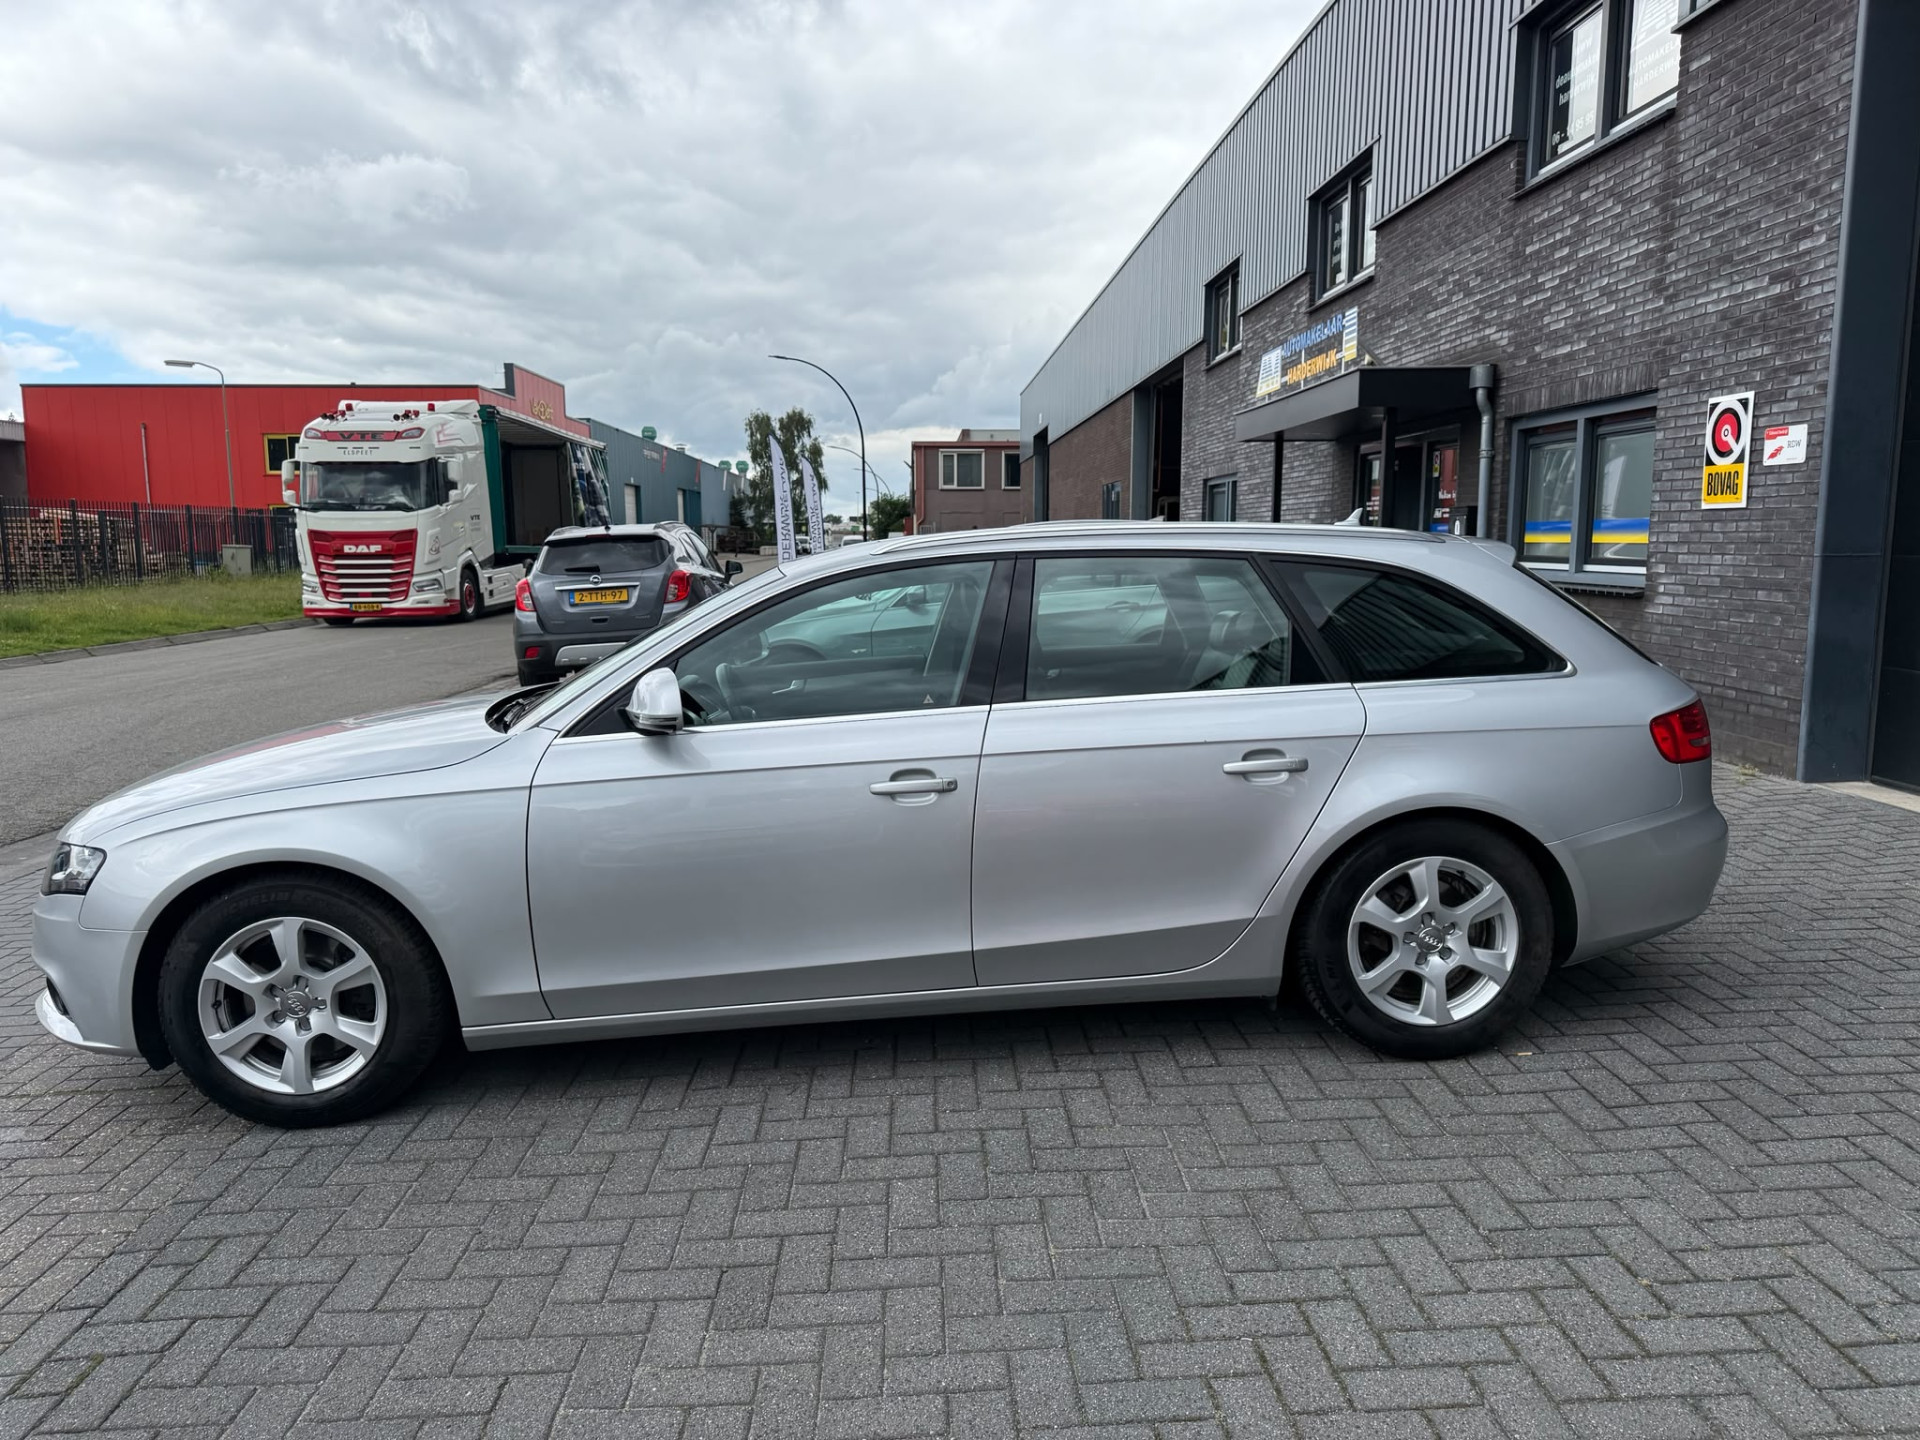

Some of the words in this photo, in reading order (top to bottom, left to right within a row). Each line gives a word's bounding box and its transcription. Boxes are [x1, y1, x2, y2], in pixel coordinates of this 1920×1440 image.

[1281, 313, 1343, 358] AUTOMAKELAAR
[1287, 348, 1338, 386] HARDERWIJK
[338, 432, 385, 440] VTE
[1707, 470, 1739, 496] BOVAG
[343, 544, 382, 553] DAF
[578, 590, 624, 602] 2-TTH-97
